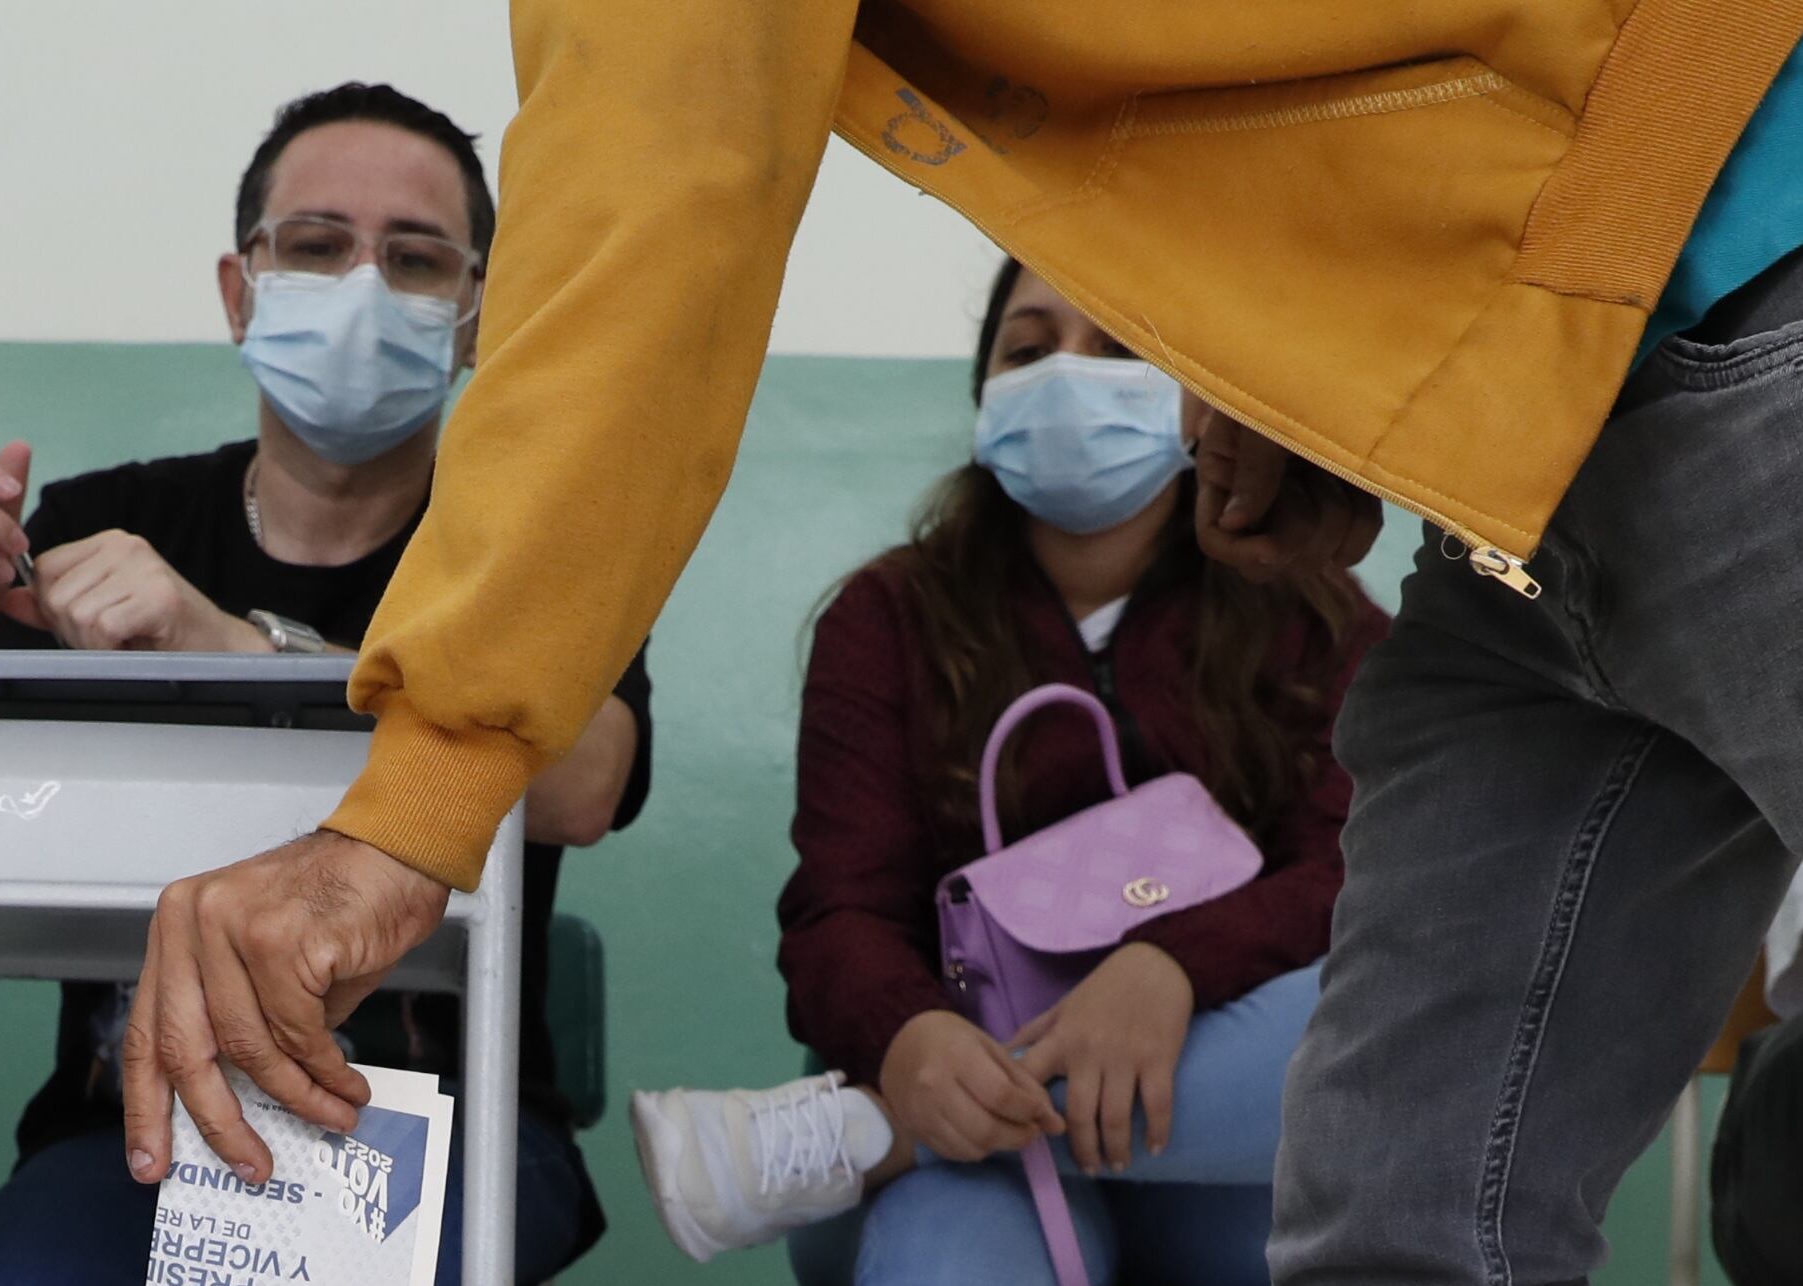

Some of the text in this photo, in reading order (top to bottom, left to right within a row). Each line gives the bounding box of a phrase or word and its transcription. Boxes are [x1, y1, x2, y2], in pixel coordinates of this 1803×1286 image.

[344, 1136, 393, 1173] 2022
[314, 1140, 388, 1213] VOTO
[157, 1206, 251, 1240] DE LA RE
[290, 1256, 310, 1282] Y
